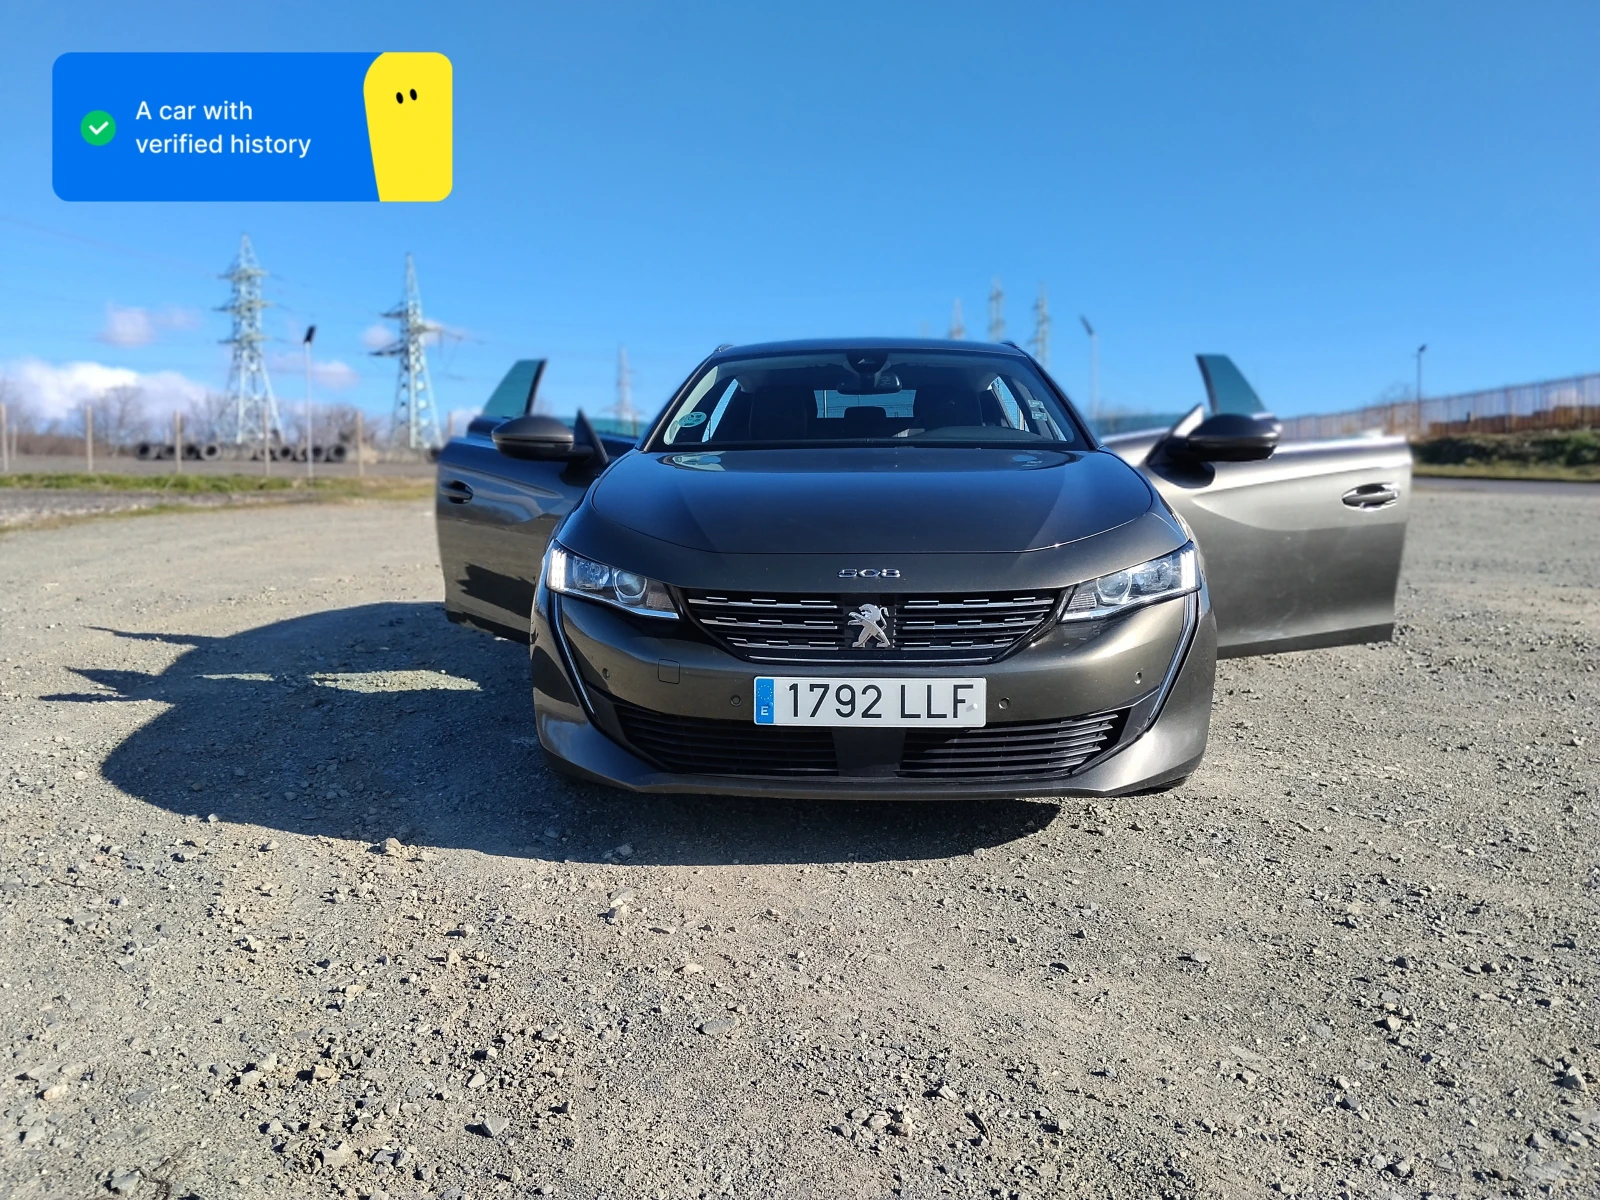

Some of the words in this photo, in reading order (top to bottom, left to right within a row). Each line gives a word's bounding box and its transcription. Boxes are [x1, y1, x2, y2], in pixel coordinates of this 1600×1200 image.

[838, 568, 901, 578] 508
[788, 682, 882, 718] 1792
[900, 684, 974, 719] LLF
[760, 705, 769, 716] E
